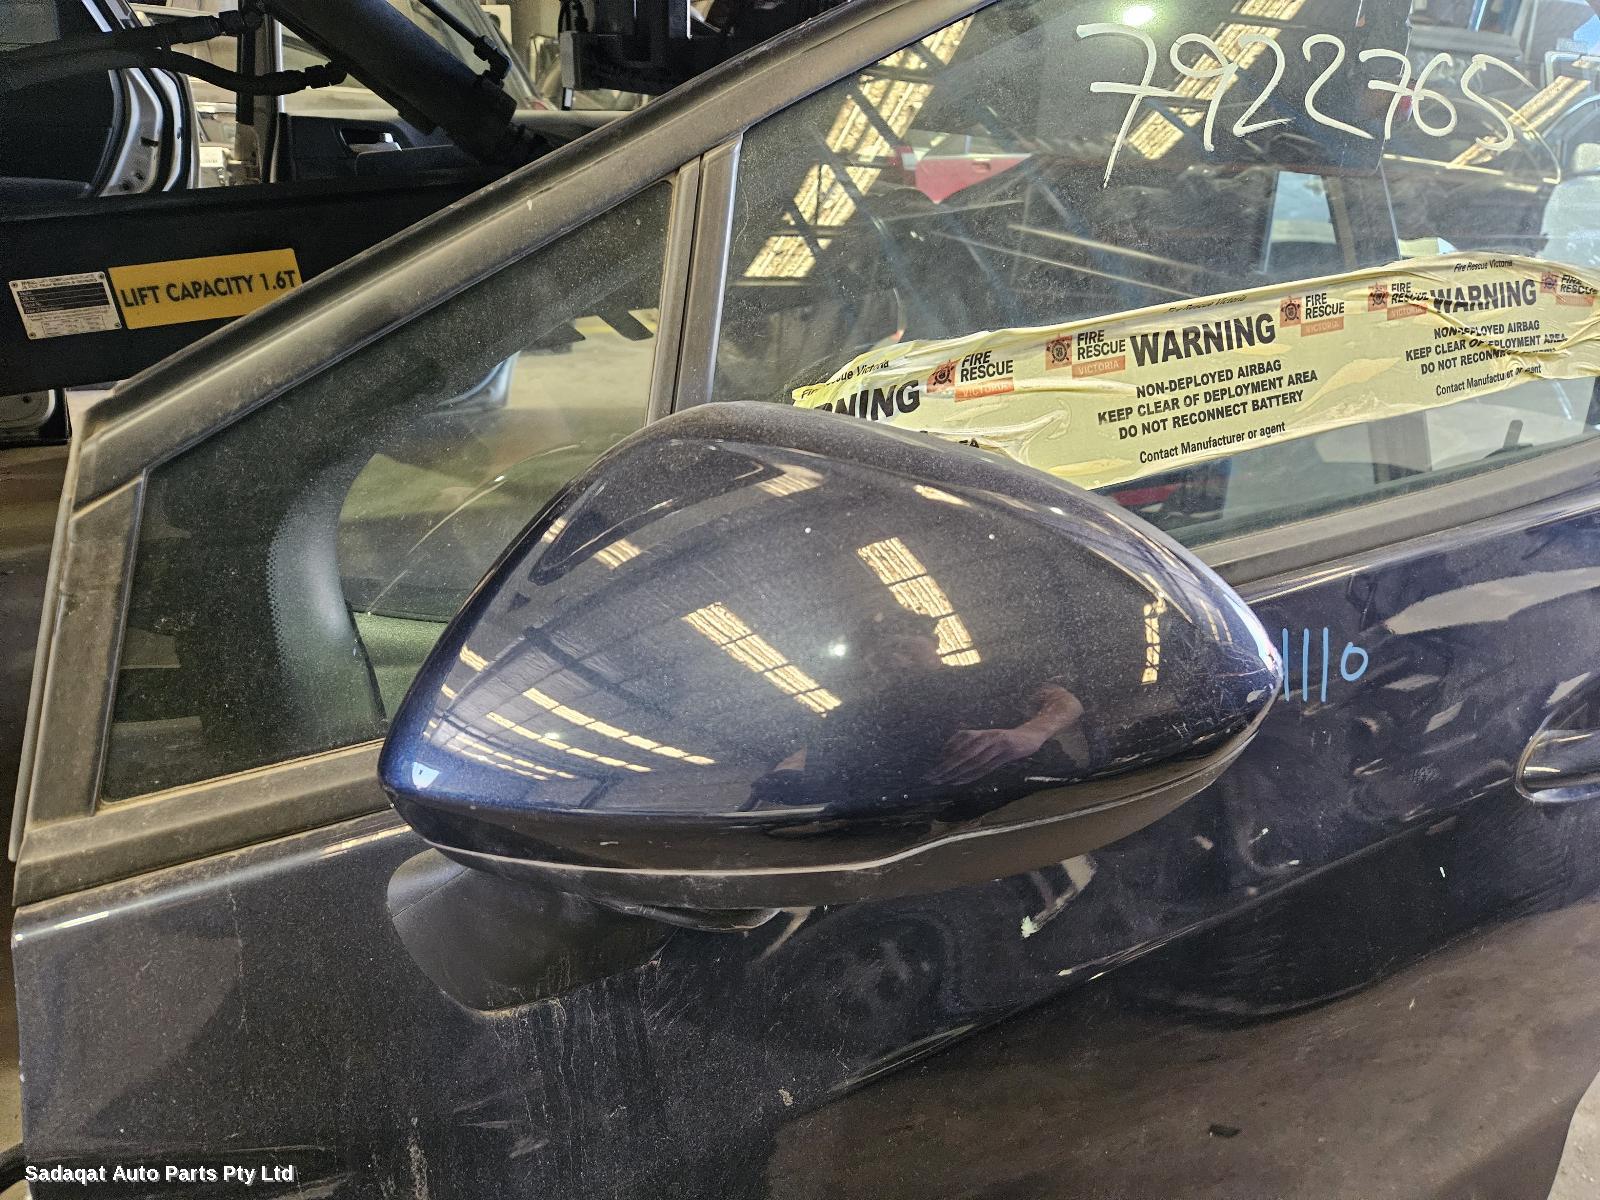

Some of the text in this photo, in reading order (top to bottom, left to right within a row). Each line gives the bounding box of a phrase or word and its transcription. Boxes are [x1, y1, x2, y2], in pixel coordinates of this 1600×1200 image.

[1076, 23, 1536, 189] 7922765
[120, 270, 295, 307] LIFT CAPACITY 1.6T
[1391, 282, 1411, 292] FIRE
[1305, 293, 1327, 307] FIRE
[1305, 302, 1344, 319] RESCUE
[1507, 320, 1540, 333] AIRBAG
[1077, 330, 1105, 346] FIRE
[1130, 313, 1276, 367] WARNING
[962, 351, 992, 367] FIRE
[1077, 339, 1126, 360] RESCUE
[1405, 347, 1432, 361] KEEP
[1435, 339, 1466, 355] CLEAR
[961, 360, 1013, 382] RESCUE
[1079, 360, 1120, 375] VICTORIA
[1421, 362, 1435, 374] DO
[1438, 357, 1458, 371] NOT
[1136, 359, 1282, 398] NON-DEPLOYED AIRBAG
[1436, 382, 1465, 396] Contact
[1097, 369, 1318, 425] KEEP CLEAR OF DEPLOYMENT AREA
[1119, 390, 1305, 440] DO NOT RECONNECT BATTERY
[1139, 421, 1286, 464] Contact Manufacturer or agent
